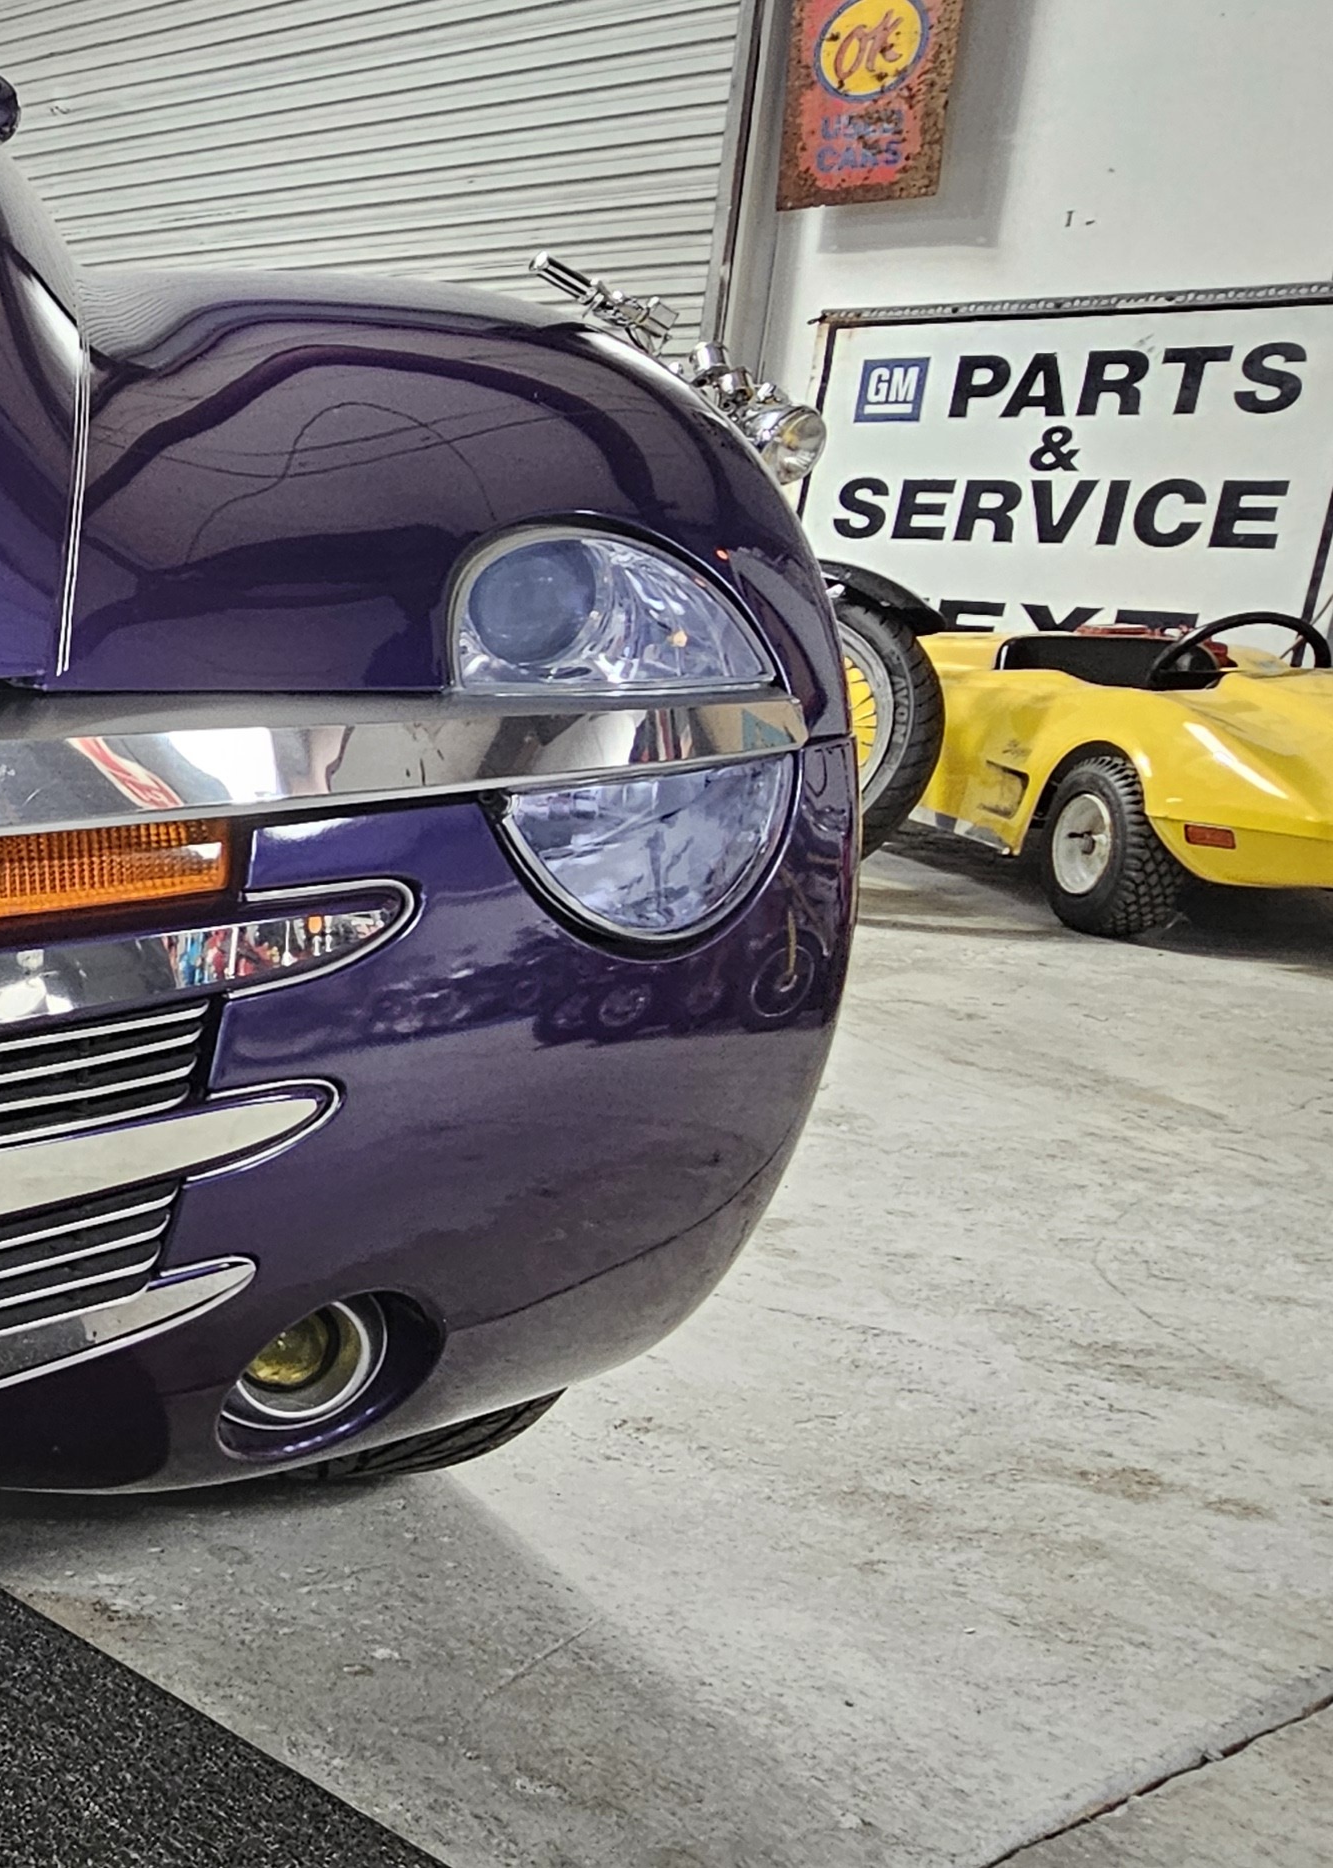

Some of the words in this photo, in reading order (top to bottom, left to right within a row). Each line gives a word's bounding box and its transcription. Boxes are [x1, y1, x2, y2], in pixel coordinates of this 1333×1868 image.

[815, 139, 903, 173] CARS
[866, 365, 921, 404] GM
[948, 342, 1307, 419] PARTS
[1029, 425, 1081, 472] &
[833, 477, 1291, 549] SERVICE
